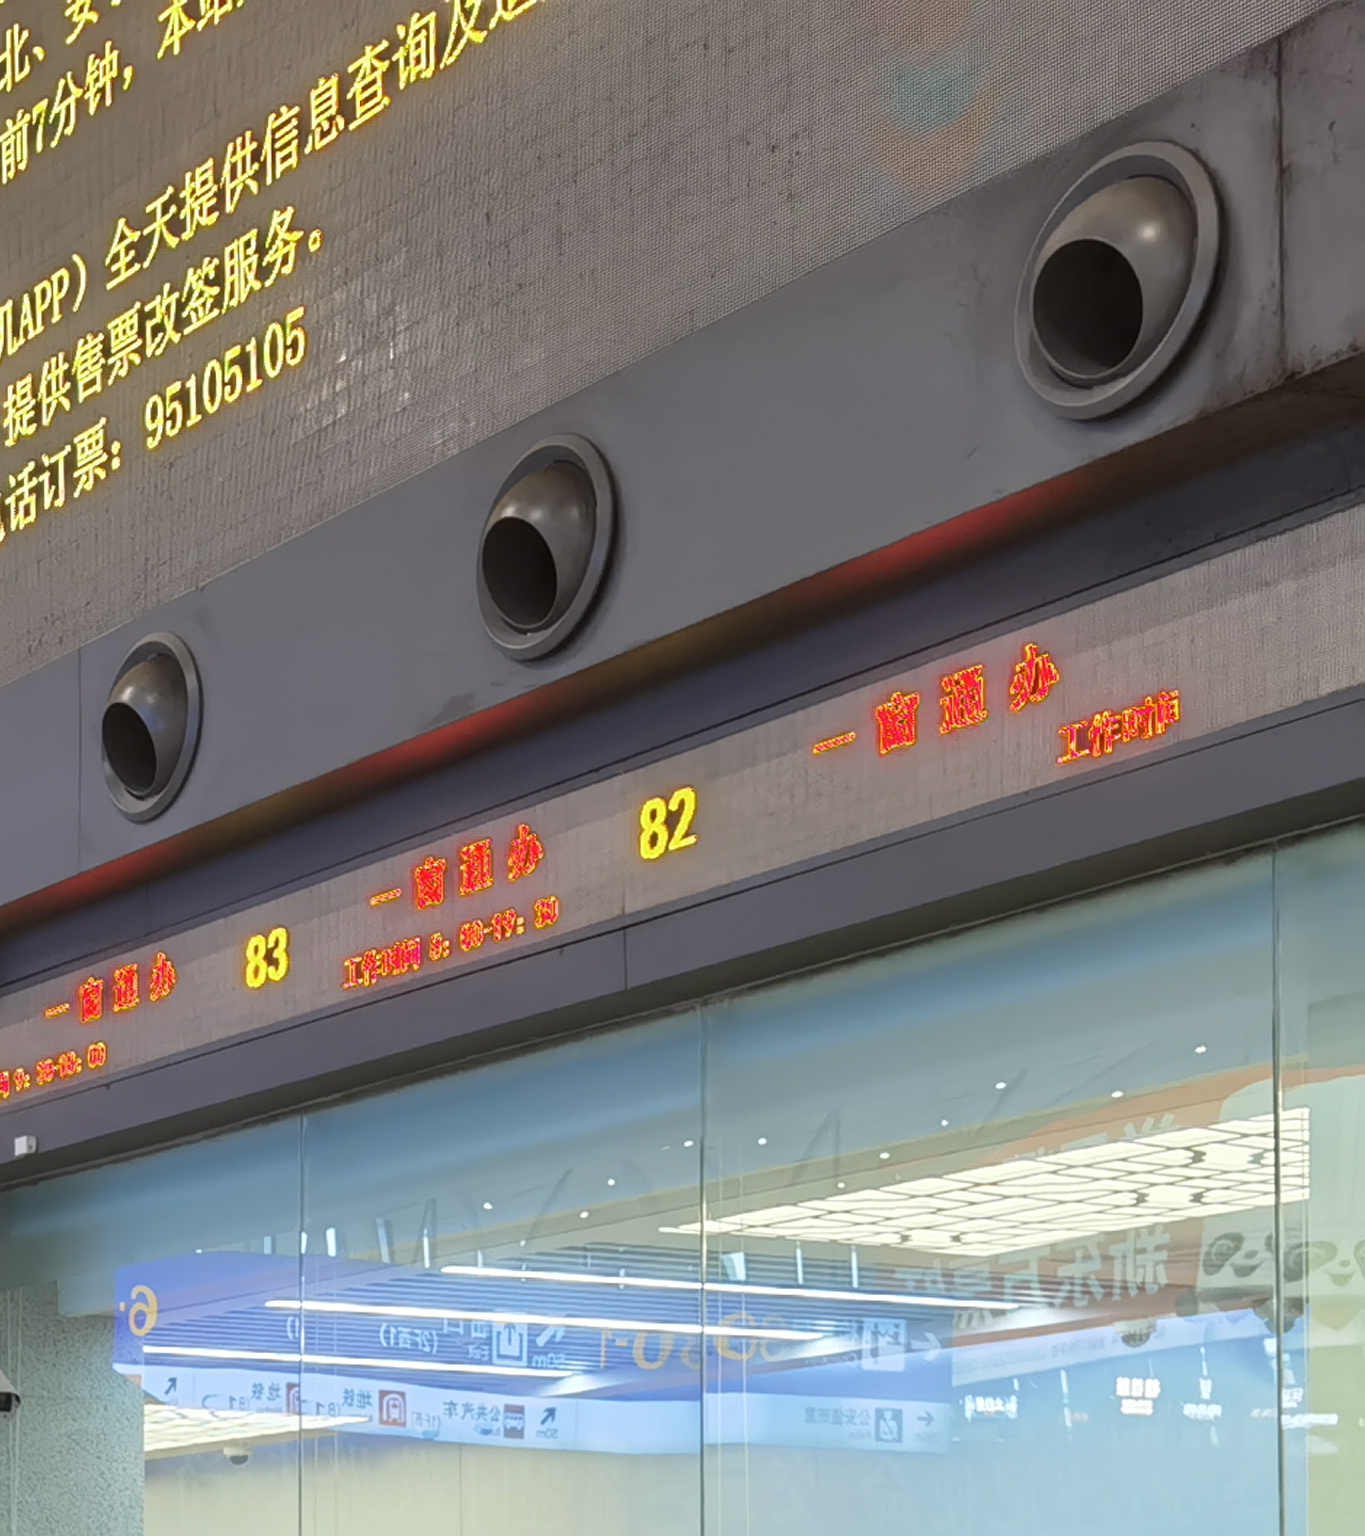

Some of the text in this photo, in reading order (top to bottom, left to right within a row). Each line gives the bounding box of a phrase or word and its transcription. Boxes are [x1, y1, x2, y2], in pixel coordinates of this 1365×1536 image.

[637, 786, 698, 861] 82
[812, 643, 1061, 755] 一窗通办
[45, 951, 177, 1024] 一窗通办
[244, 823, 546, 989] 83 一窗通办
